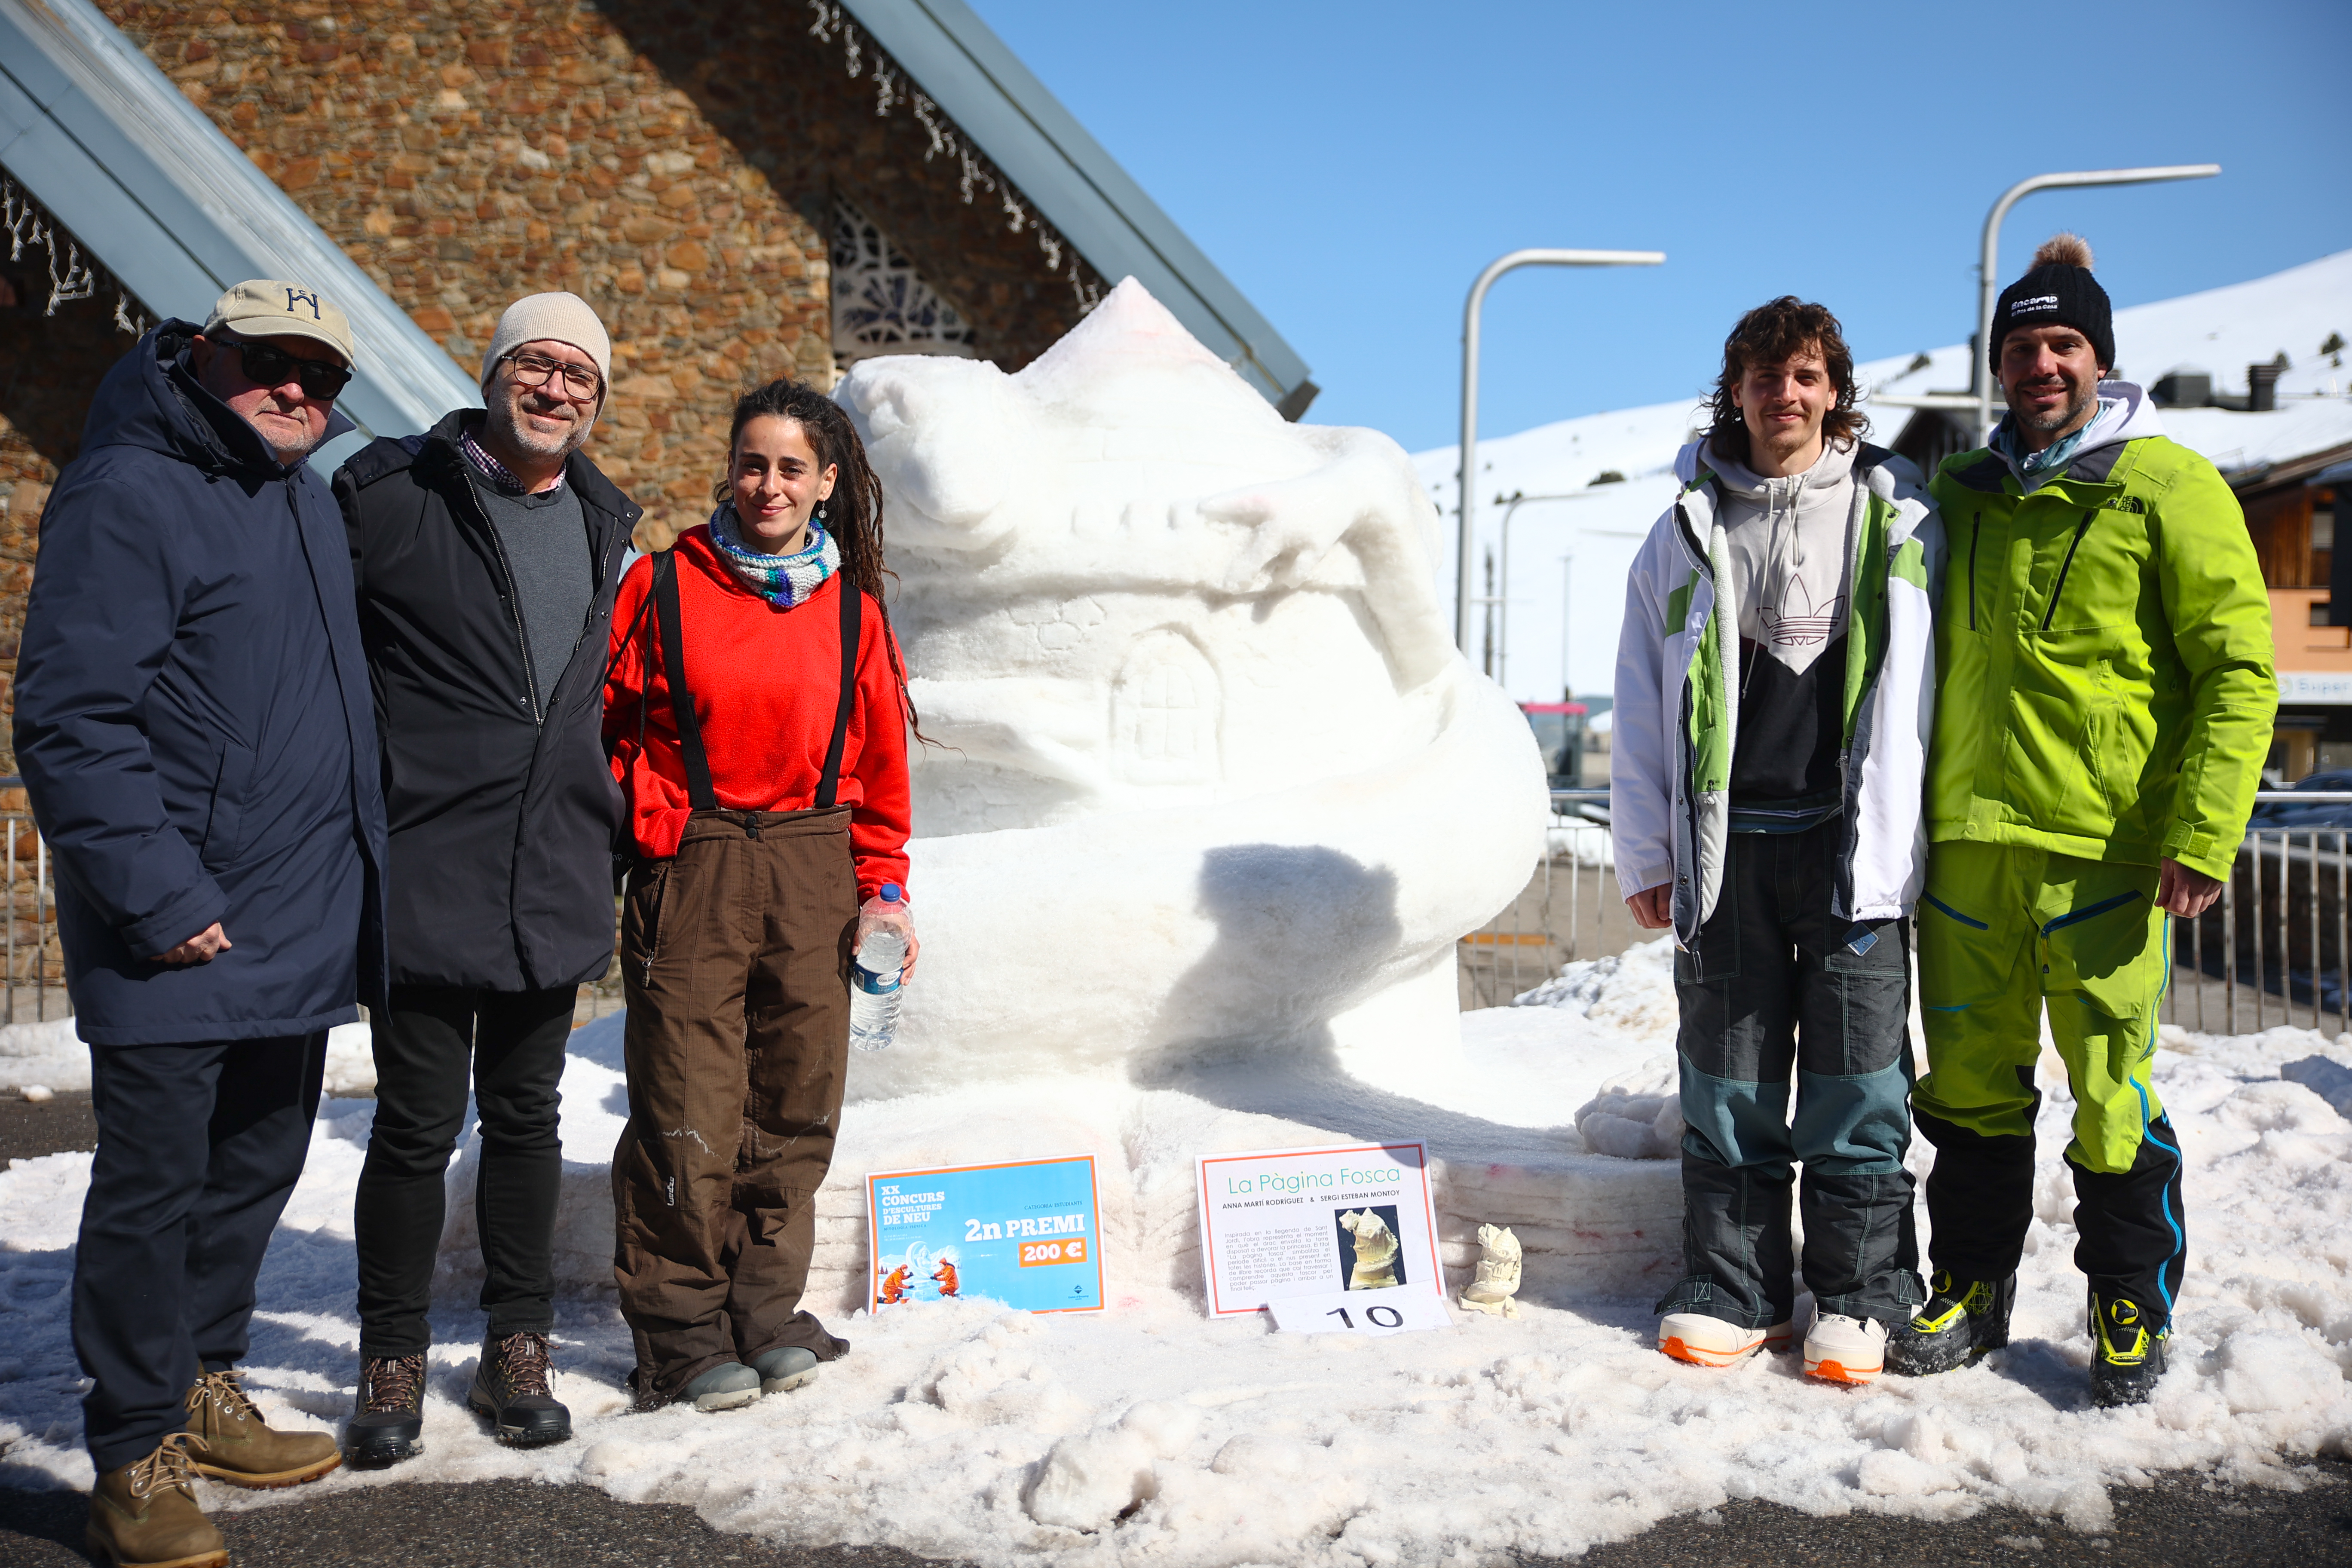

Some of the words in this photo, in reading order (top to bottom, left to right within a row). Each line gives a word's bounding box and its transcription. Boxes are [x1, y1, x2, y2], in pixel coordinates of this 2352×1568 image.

[2012, 296, 2058, 310] Encamp
[1228, 1177, 1252, 1194] La
[1259, 1171, 1333, 1194] Pàgina
[1340, 1168, 1400, 1185] Fosca
[881, 1185, 900, 1195] XX
[1244, 1199, 1264, 1207] MARTÍ
[1266, 1197, 1304, 1206] RODRÍGUEZ
[1370, 1189, 1400, 1198] MONTOY
[882, 1191, 945, 1207] CONCURS
[882, 1203, 942, 1215] D'ESCULTURES
[883, 1214, 901, 1225] DE
[903, 1211, 931, 1223] NEU
[965, 1219, 1002, 1242] 2n
[1005, 1214, 1085, 1238] PREMI
[1024, 1243, 1060, 1262] 200
[1065, 1242, 1082, 1257] €
[1326, 1306, 1403, 1328] 10
